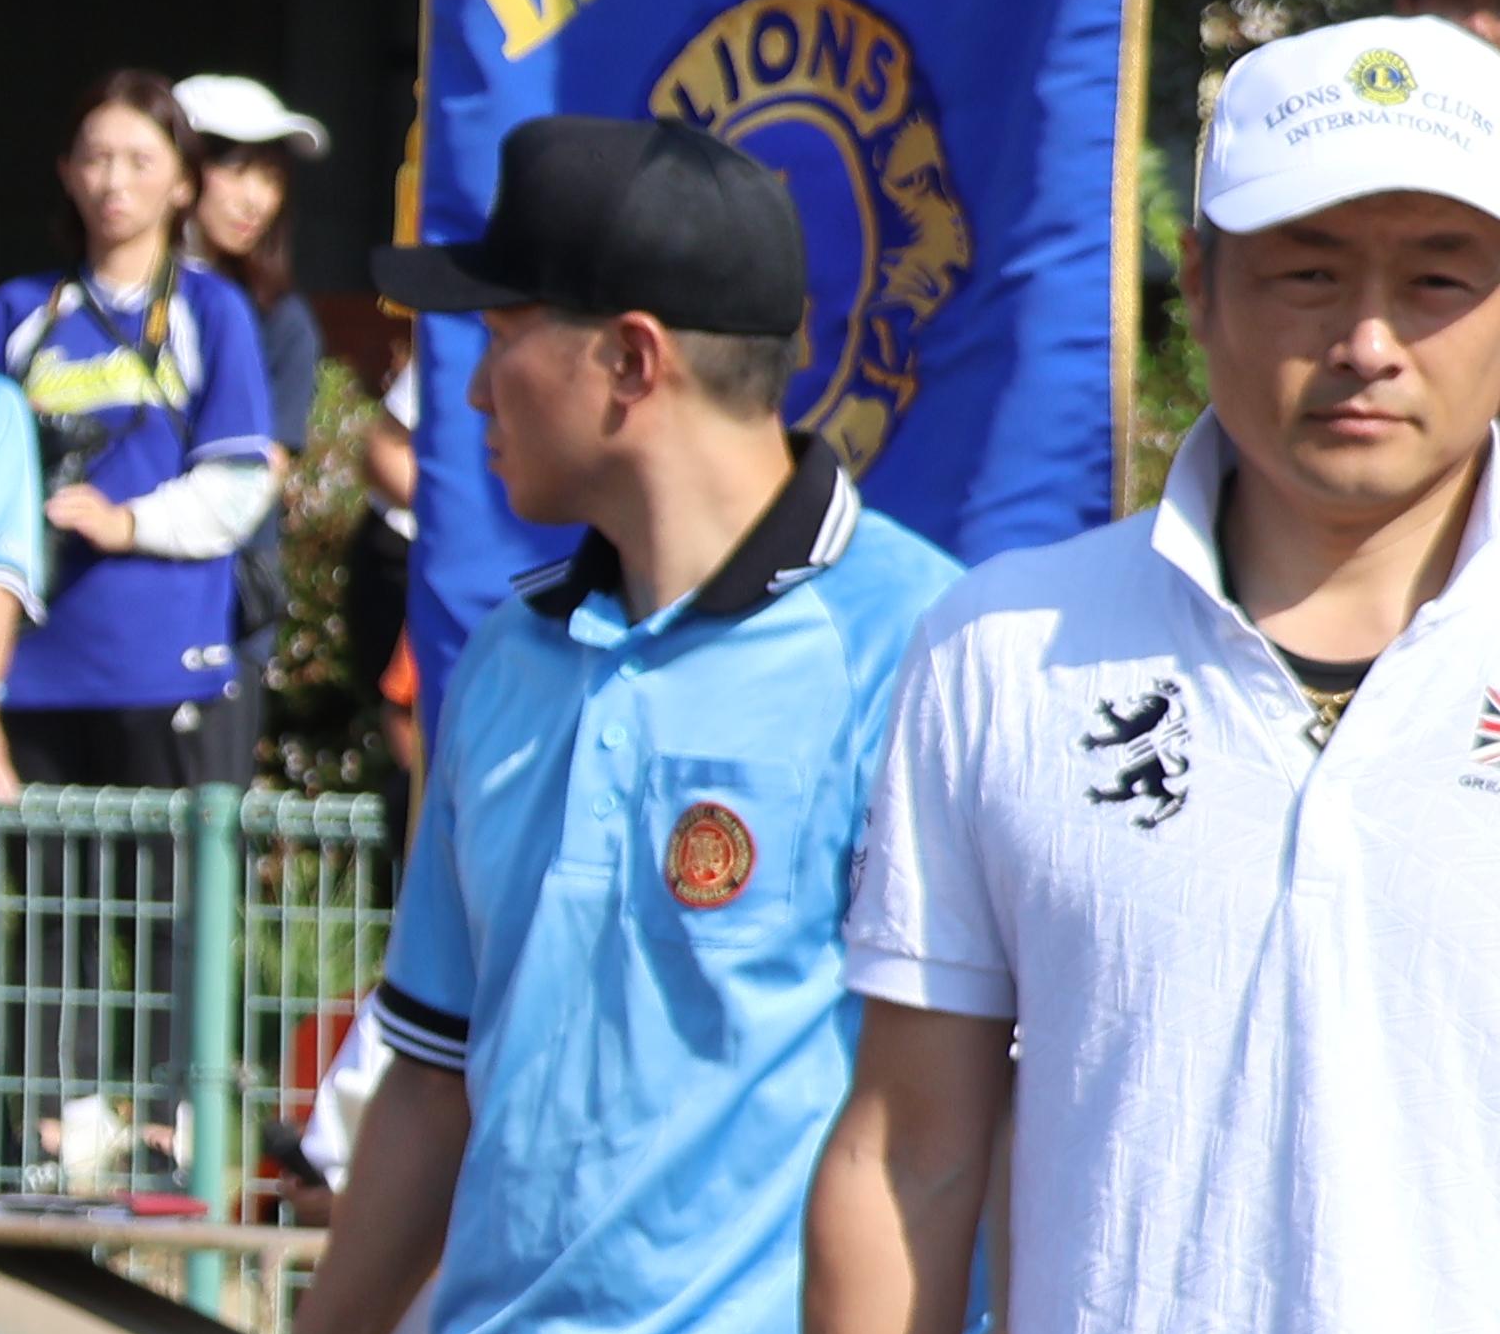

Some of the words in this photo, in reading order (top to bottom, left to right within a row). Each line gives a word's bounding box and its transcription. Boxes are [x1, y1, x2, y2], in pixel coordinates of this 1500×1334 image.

[671, 3, 896, 129] LIONS
[1263, 83, 1342, 132] LIONS
[1421, 90, 1494, 137] CLUBS
[1284, 108, 1474, 153] INTERNATIONAL
